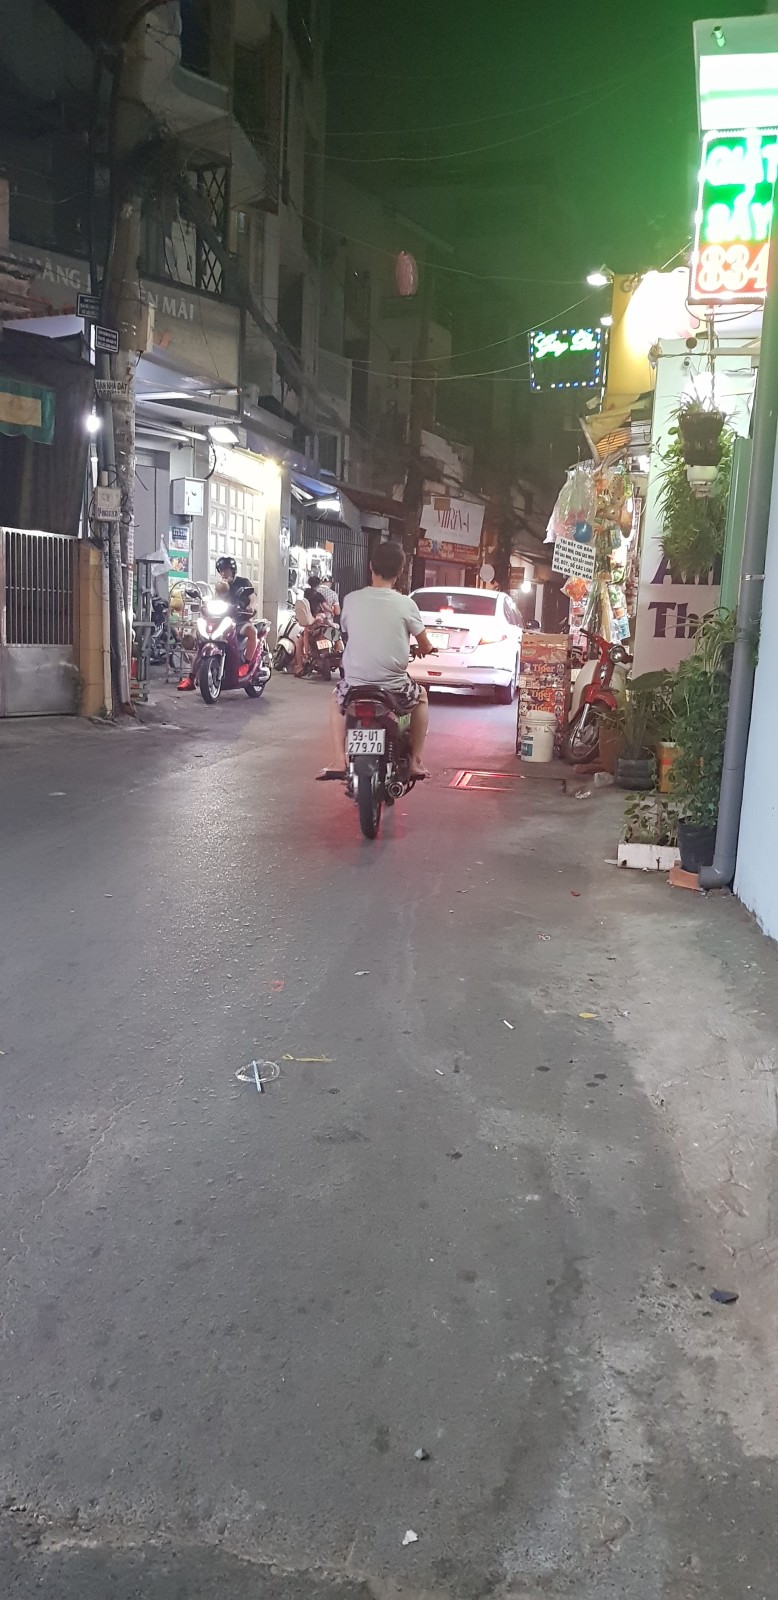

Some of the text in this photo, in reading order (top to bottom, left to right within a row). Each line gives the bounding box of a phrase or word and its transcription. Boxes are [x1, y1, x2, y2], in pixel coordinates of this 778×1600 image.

[699, 244, 769, 291] 834
[532, 663, 555, 673] Tiger
[531, 689, 553, 701] Tiger
[353, 731, 378, 741] 59-U1
[349, 742, 382, 753] 279.70
